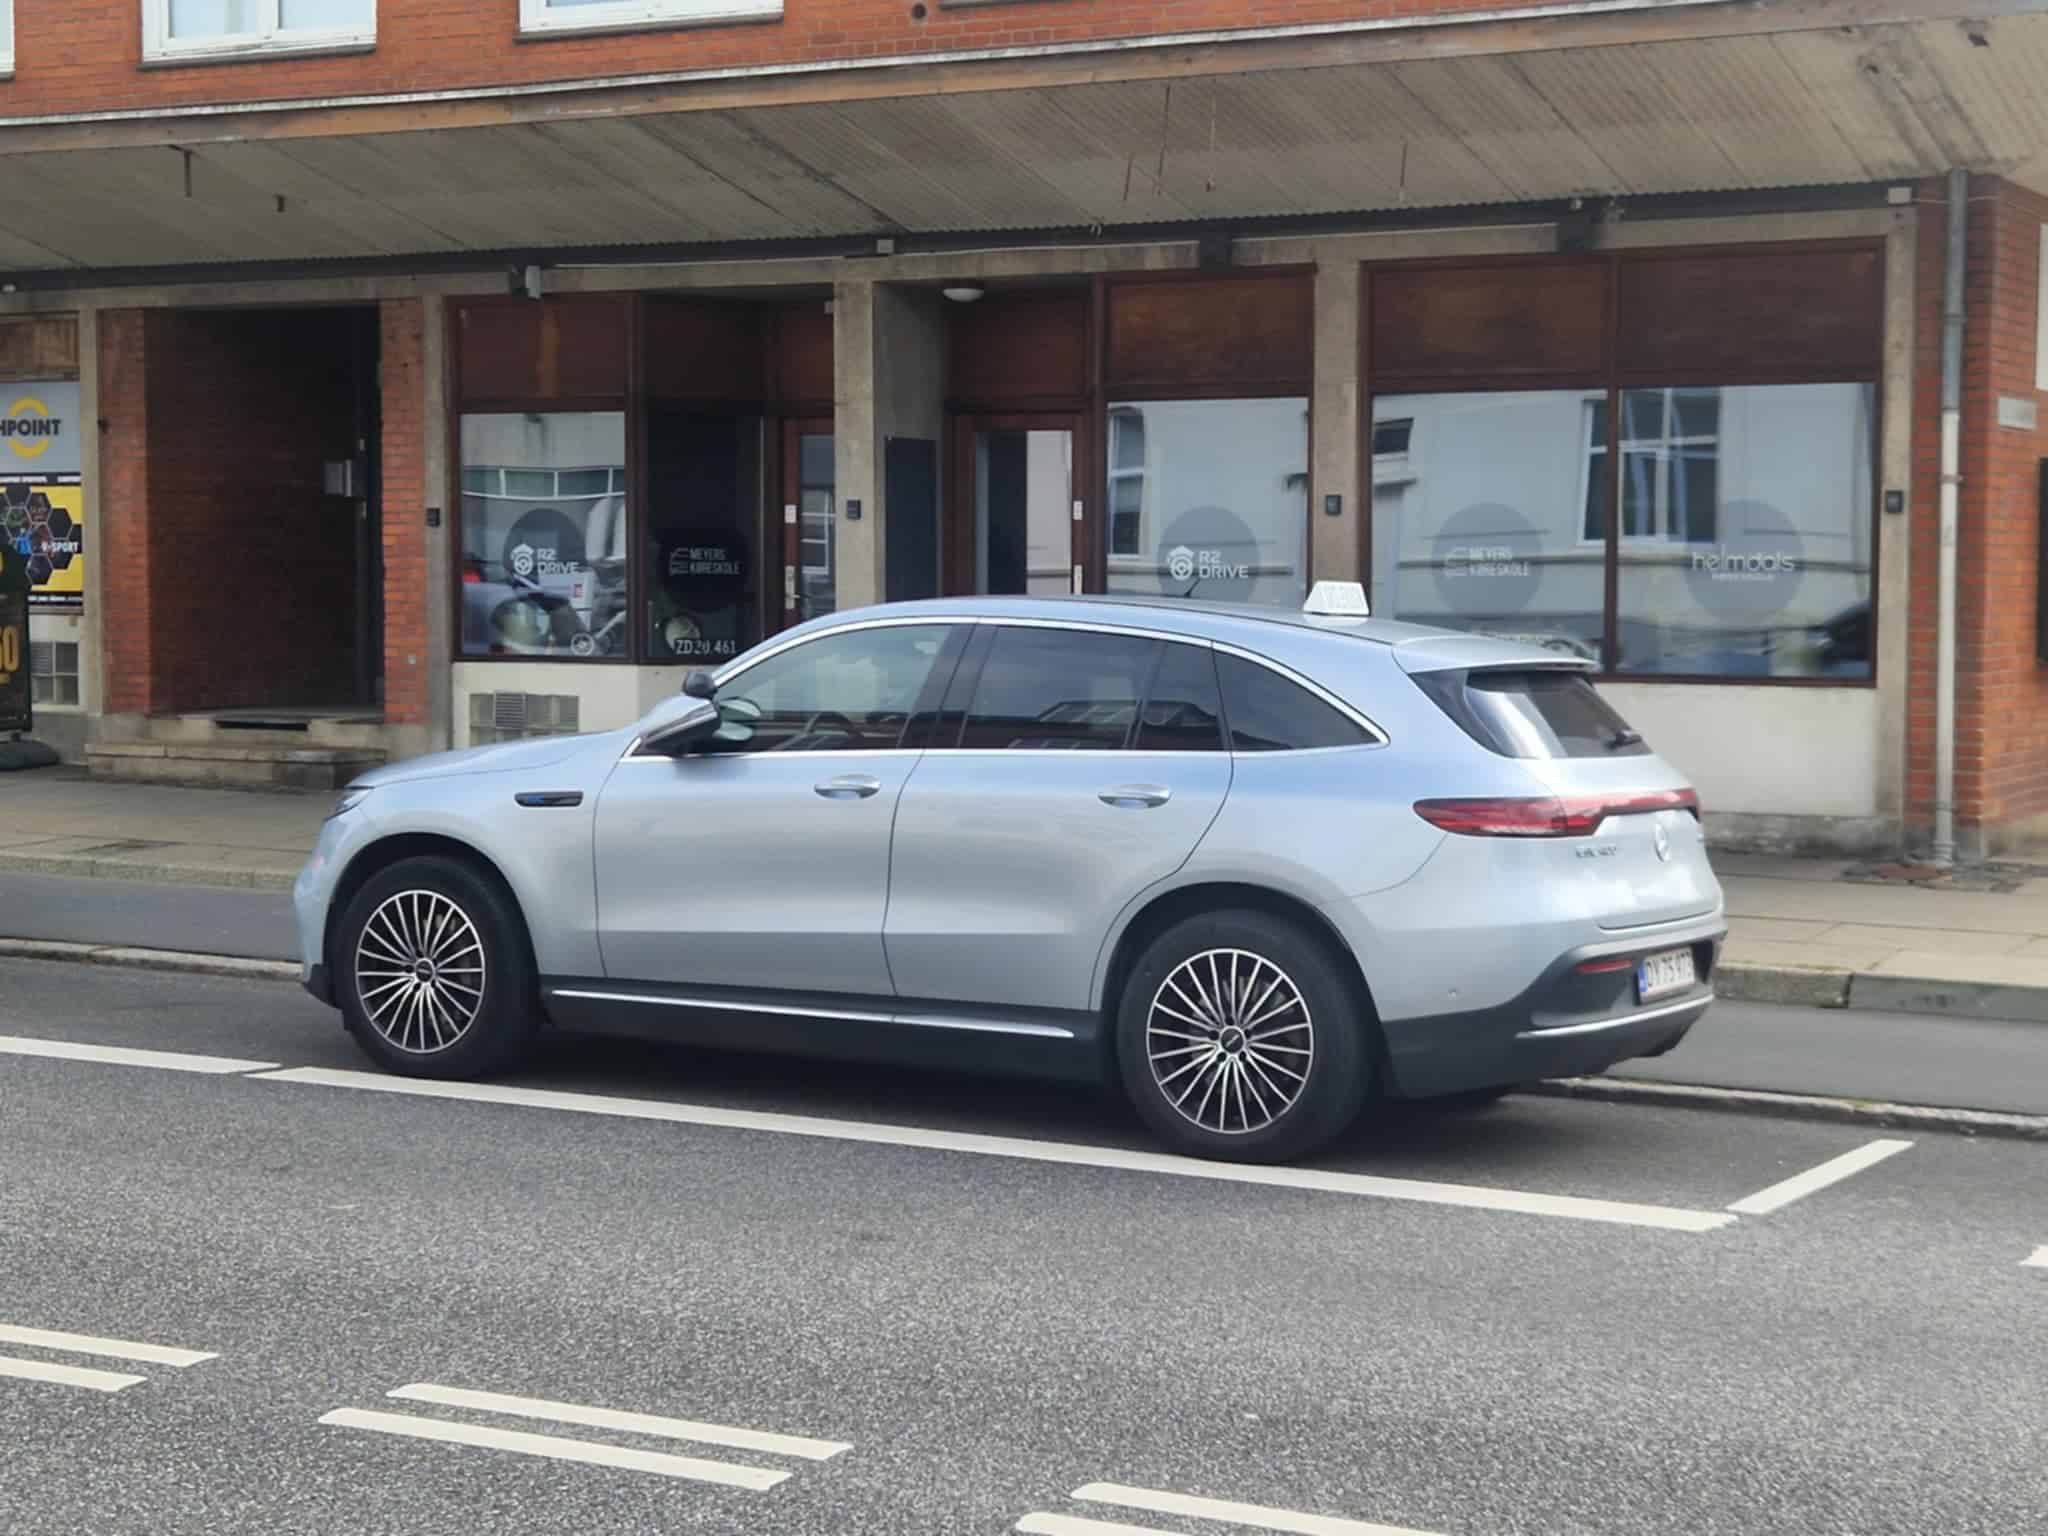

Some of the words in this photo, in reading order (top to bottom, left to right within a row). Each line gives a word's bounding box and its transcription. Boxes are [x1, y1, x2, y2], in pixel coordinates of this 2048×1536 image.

[536, 548, 558, 561] R2
[689, 547, 727, 561] MEYERS
[1199, 550, 1222, 564] R2
[536, 561, 579, 575] DRIVE
[1199, 564, 1249, 579] DRIVE
